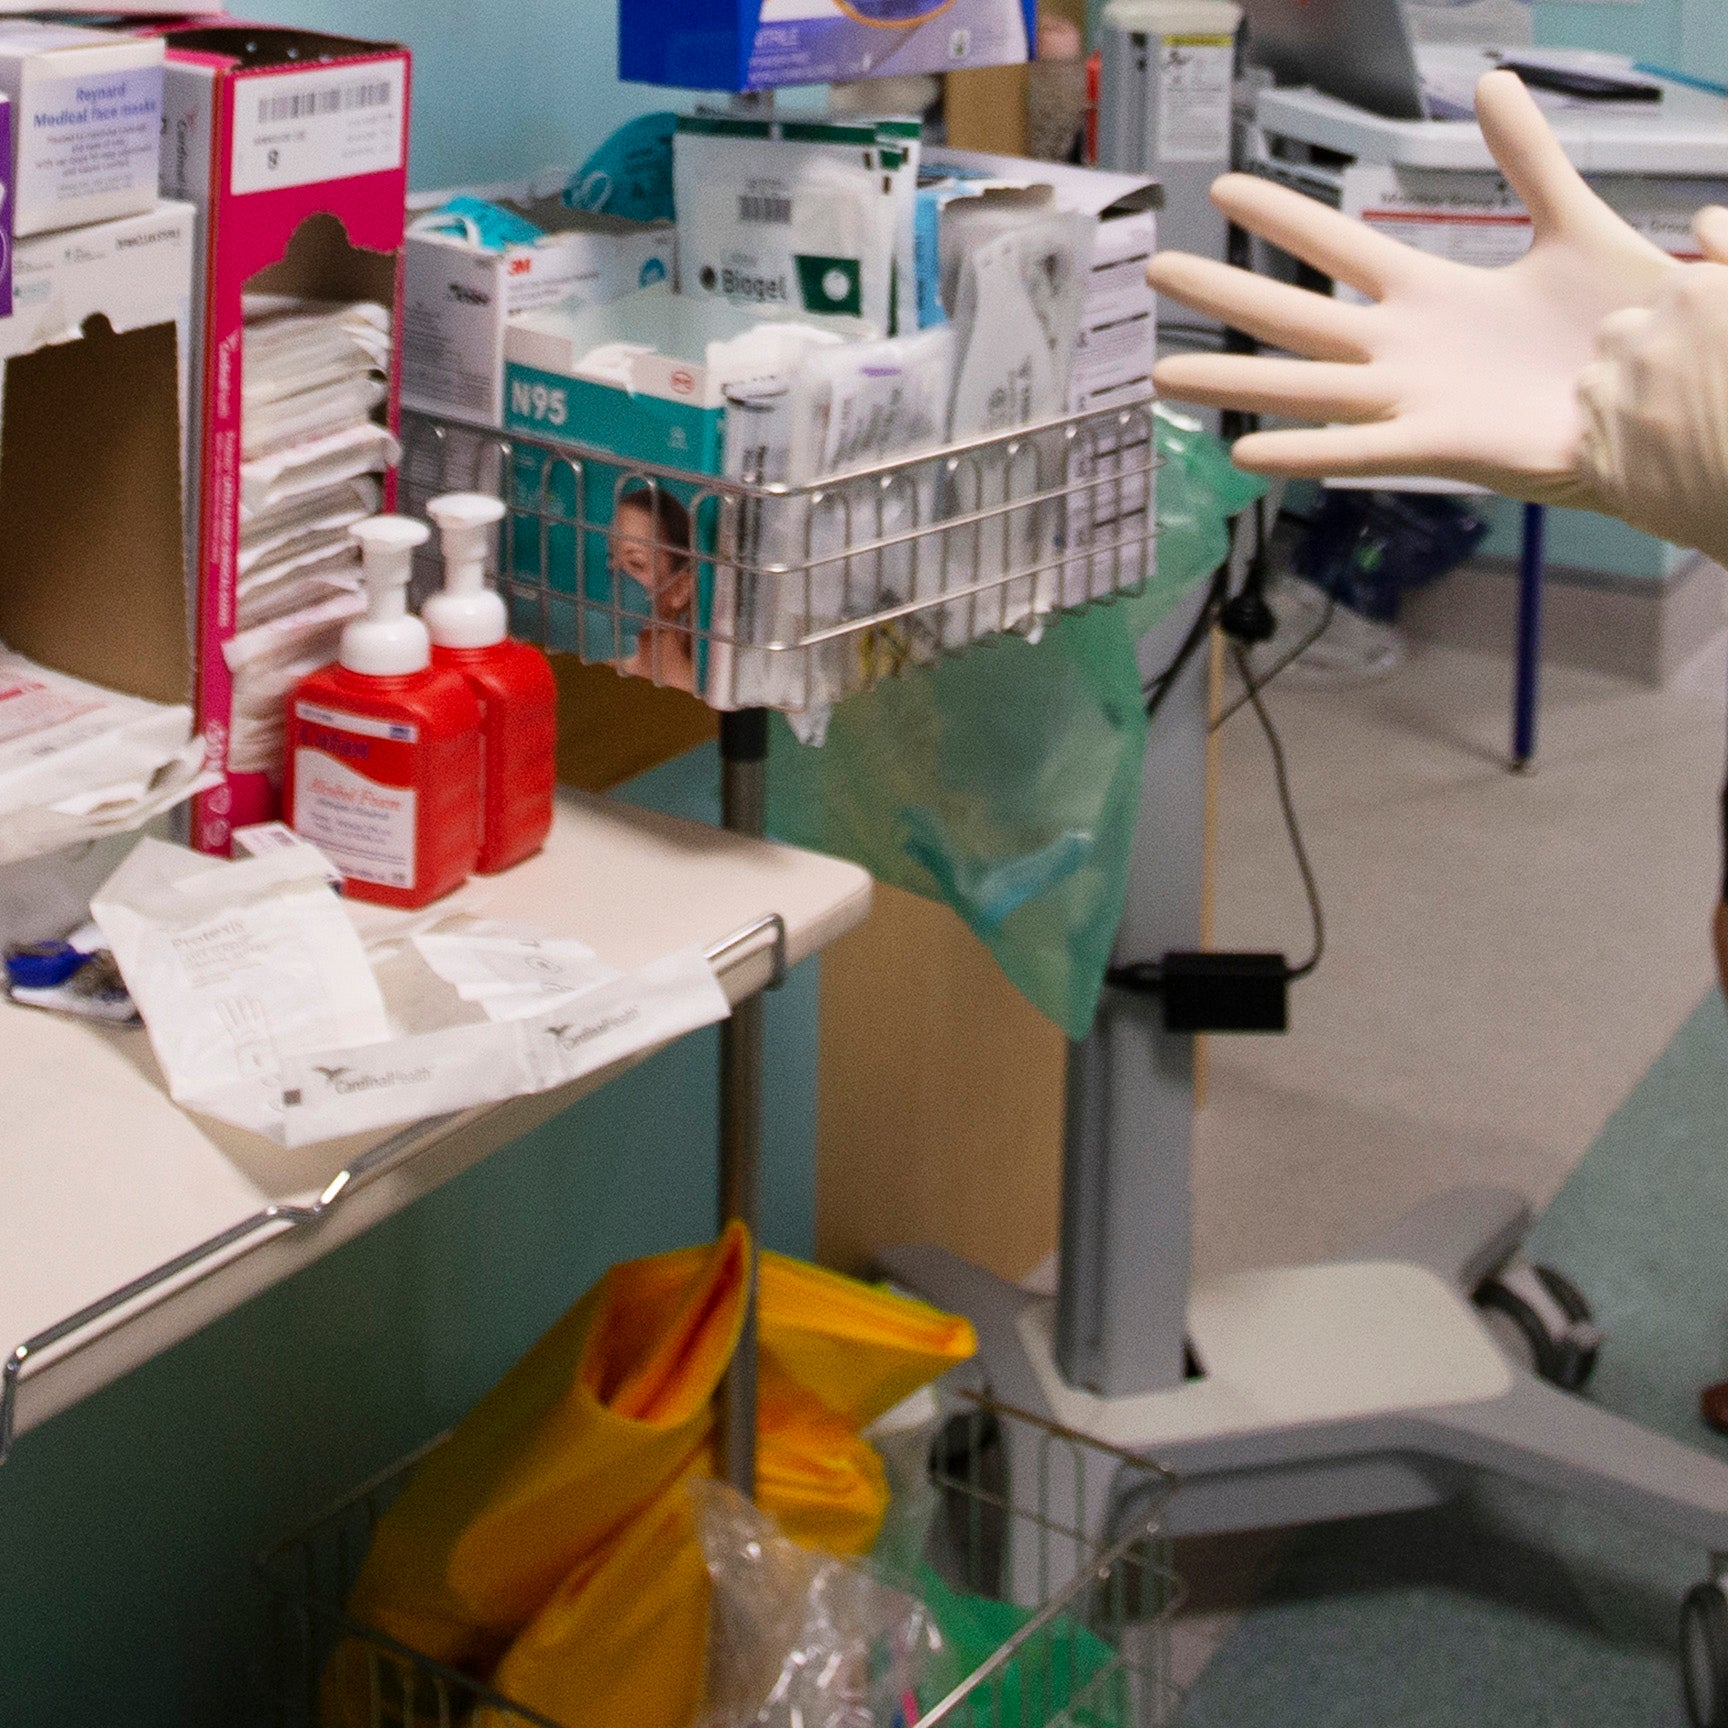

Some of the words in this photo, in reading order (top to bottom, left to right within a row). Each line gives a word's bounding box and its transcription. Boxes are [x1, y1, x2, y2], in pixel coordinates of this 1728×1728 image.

[76, 83, 126, 105] Reynard
[33, 108, 87, 128] Medical
[91, 105, 118, 122] face
[121, 98, 156, 116] masks
[722, 268, 787, 303] Biogel
[510, 380, 567, 426] N95
